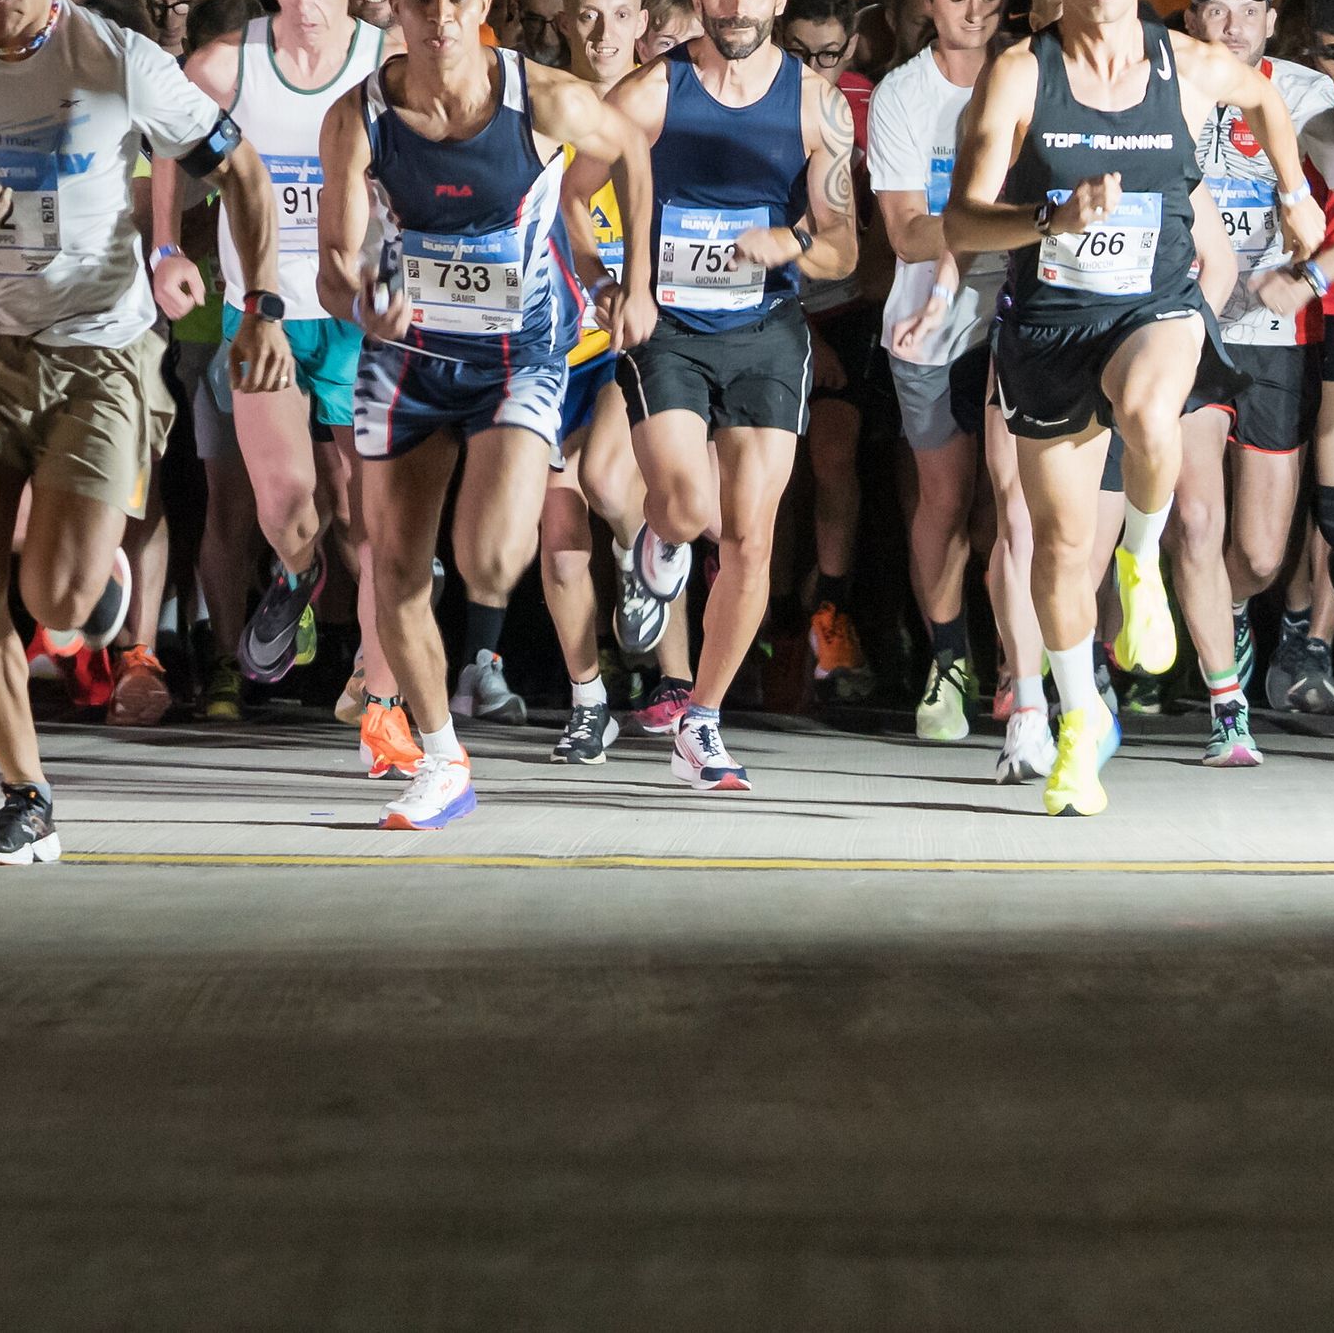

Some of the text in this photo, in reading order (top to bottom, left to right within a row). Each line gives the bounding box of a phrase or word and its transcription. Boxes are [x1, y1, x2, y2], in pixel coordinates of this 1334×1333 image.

[1042, 132, 1174, 151] TOP4RUNNING
[283, 186, 323, 215] 91
[434, 185, 474, 198] FILA
[1075, 231, 1126, 258] 766
[434, 262, 491, 293] 733
[695, 276, 732, 285] GIOVANNI
[450, 293, 476, 304] SAMIR
